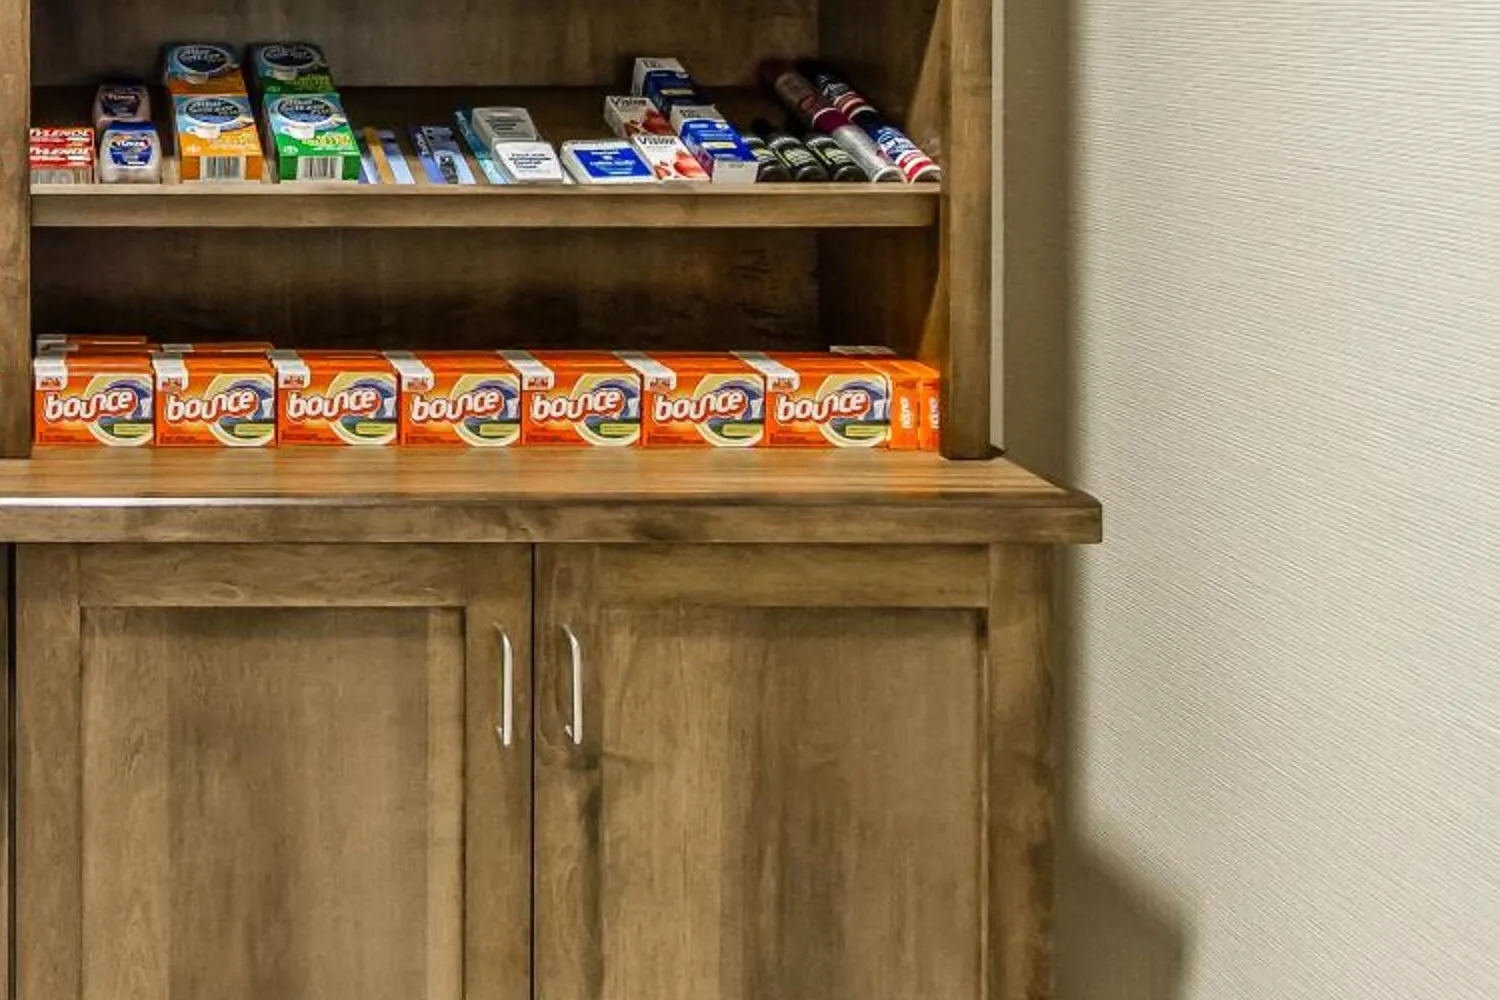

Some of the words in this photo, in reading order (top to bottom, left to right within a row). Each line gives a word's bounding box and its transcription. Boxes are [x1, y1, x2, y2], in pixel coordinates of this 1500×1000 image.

[45, 390, 133, 420] bounce
[168, 389, 254, 421] bounce
[289, 388, 378, 418] bounce
[411, 390, 501, 420] bounce
[532, 390, 621, 420] bounce
[655, 390, 744, 420] bounce
[777, 390, 867, 420] bounce
